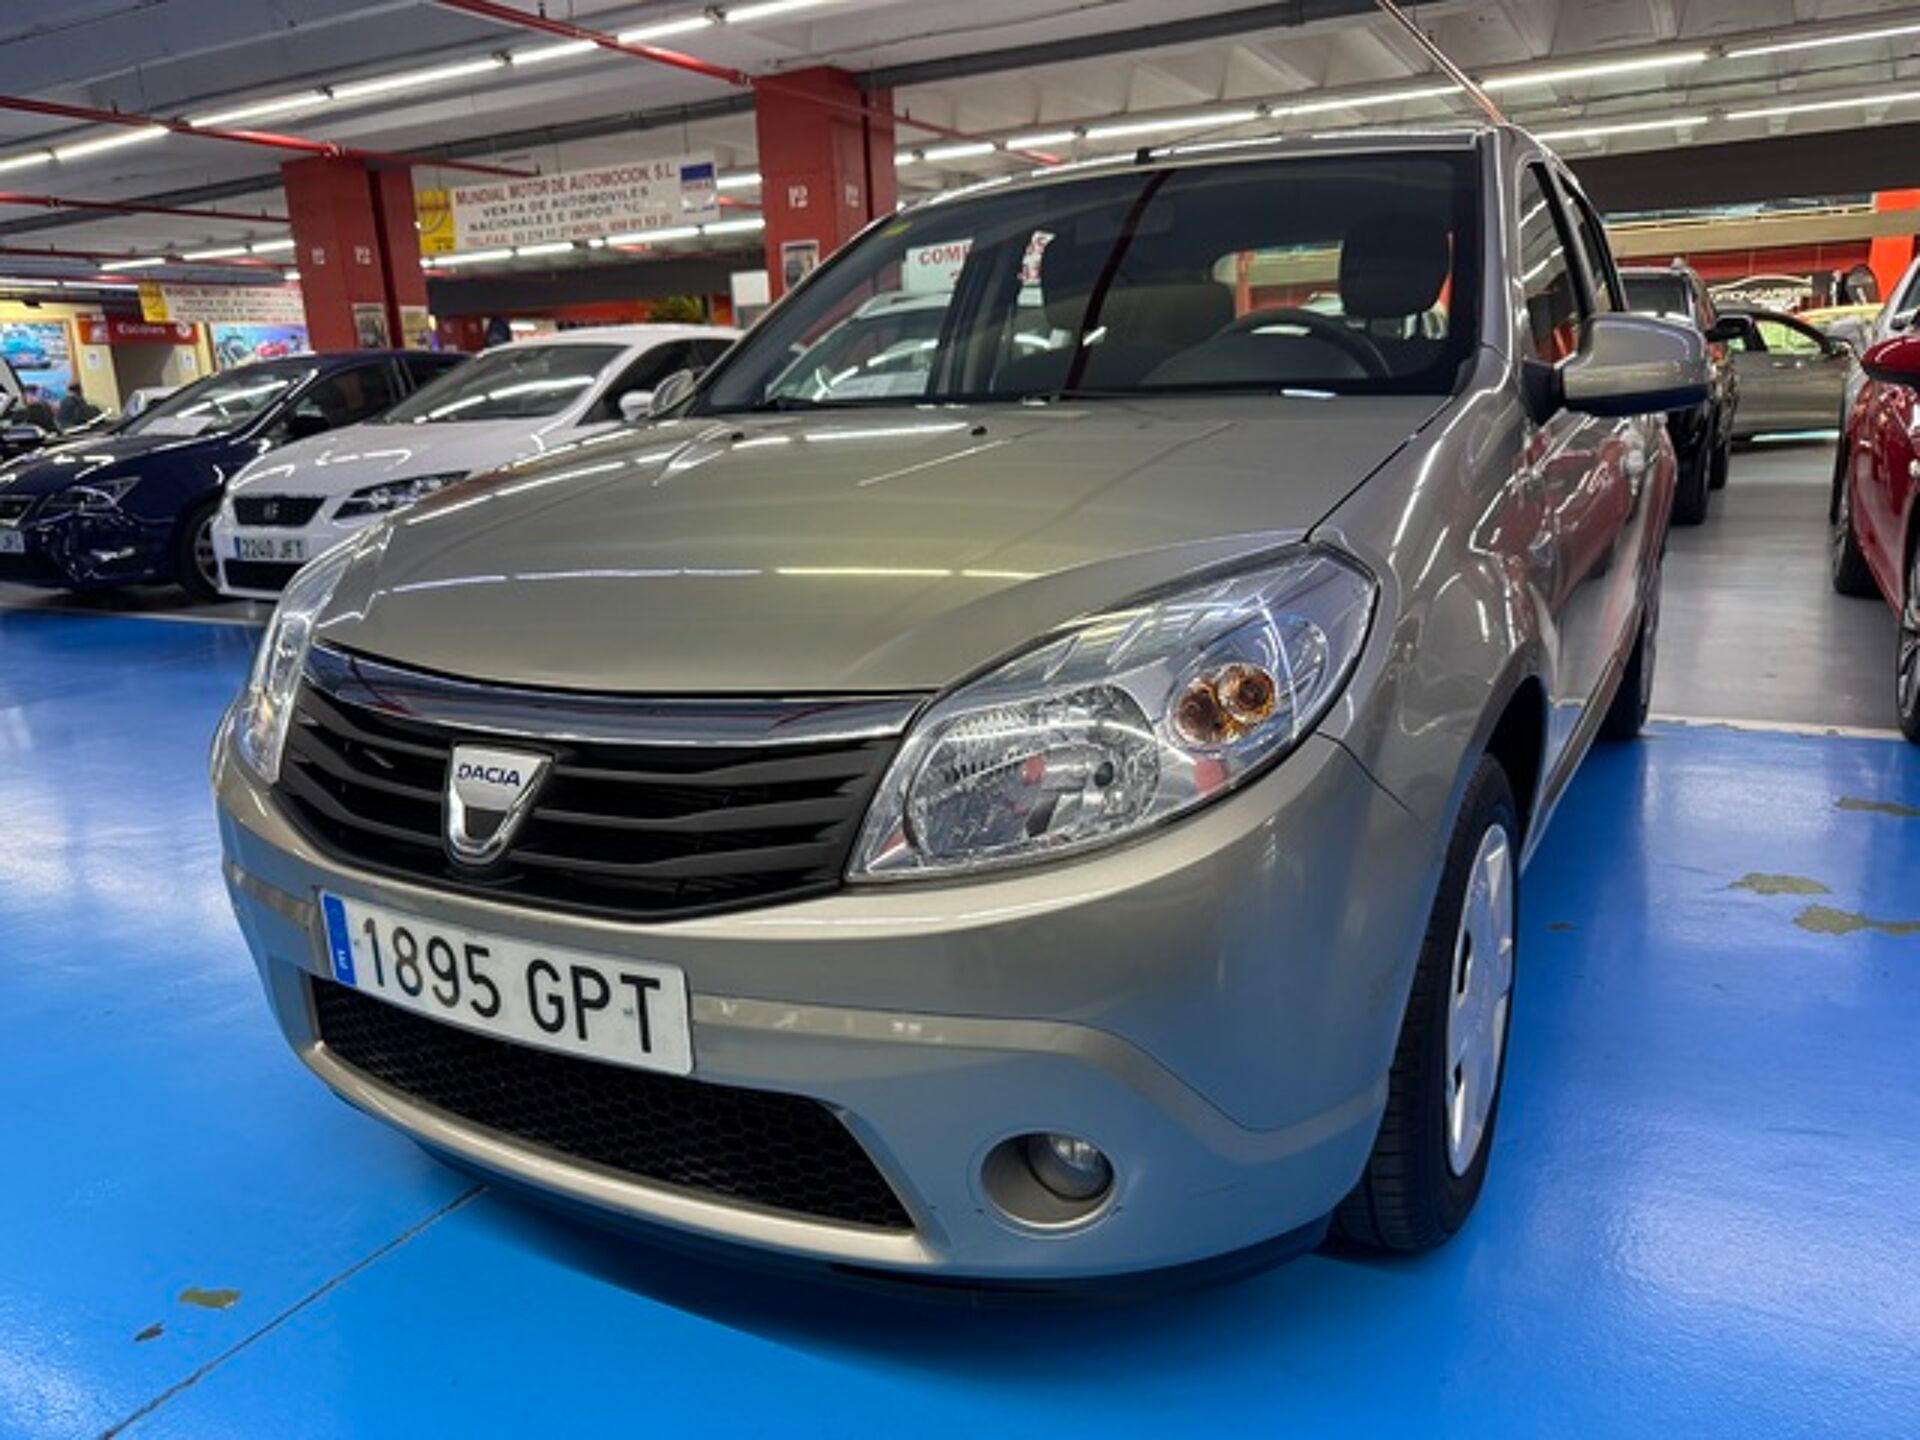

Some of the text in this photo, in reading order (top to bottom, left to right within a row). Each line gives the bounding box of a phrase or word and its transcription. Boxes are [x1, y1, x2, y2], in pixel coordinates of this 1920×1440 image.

[456, 183, 507, 205] MUNDIAL
[509, 180, 547, 199] MOTOR
[482, 187, 649, 217] VENTA DE AUTOMOVILES
[469, 212, 553, 231] NACIONALES
[457, 762, 520, 787] DACIA
[362, 916, 662, 1054] 1895 GPT
